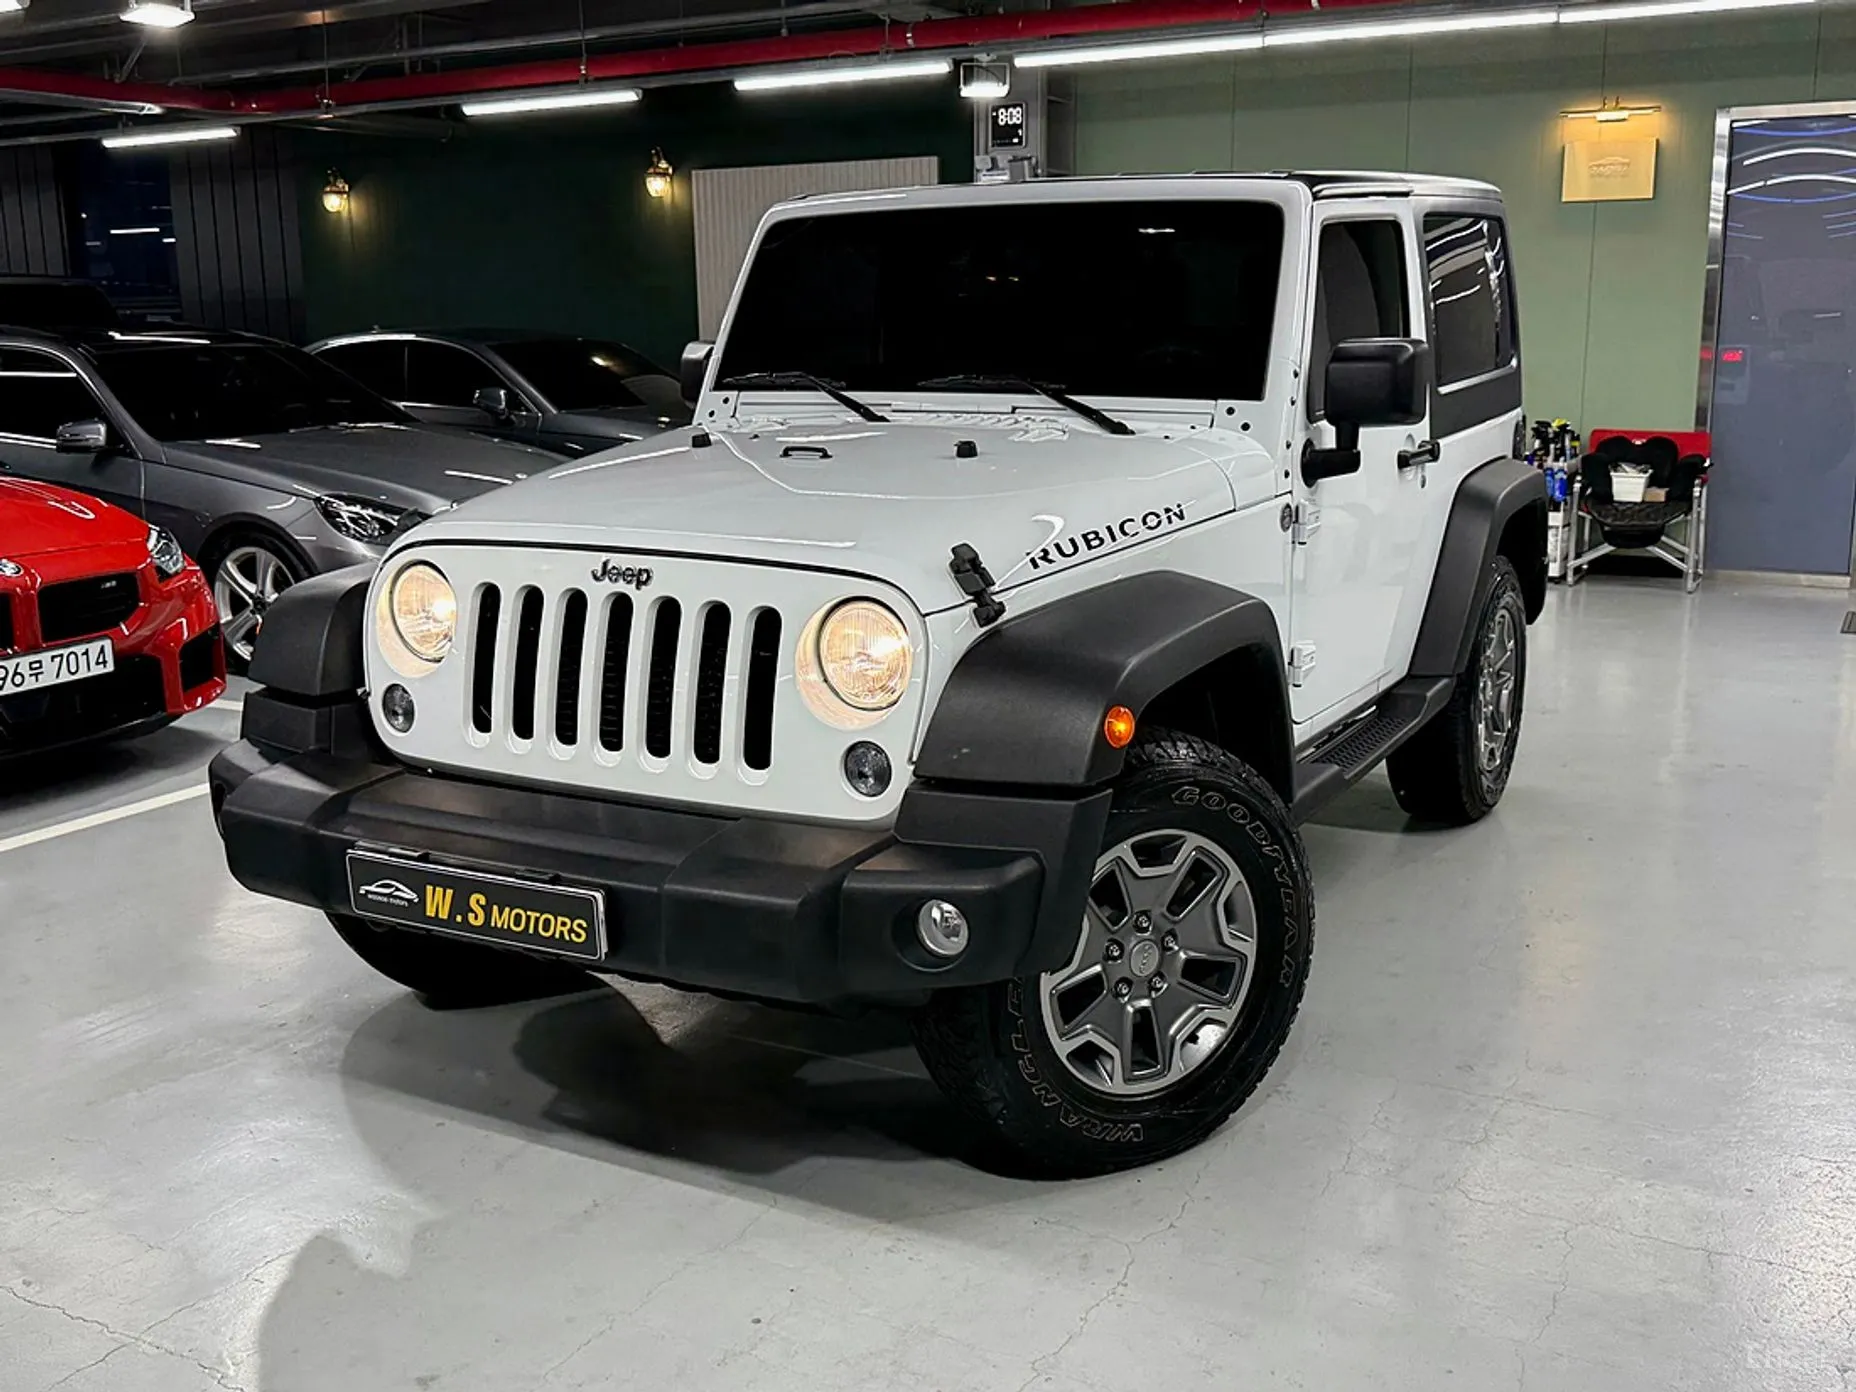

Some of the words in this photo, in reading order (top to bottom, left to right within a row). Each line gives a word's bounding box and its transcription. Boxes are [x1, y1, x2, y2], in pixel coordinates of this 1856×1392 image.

[998, 106, 1022, 126] 8:08
[1026, 503, 1186, 570] RUBICON
[591, 559, 653, 591] Jeep
[50, 644, 108, 679] 7014
[1172, 786, 1298, 988] GOODYEAR
[491, 904, 588, 944] MOTORS
[1007, 977, 1144, 1142] WRANGLE
